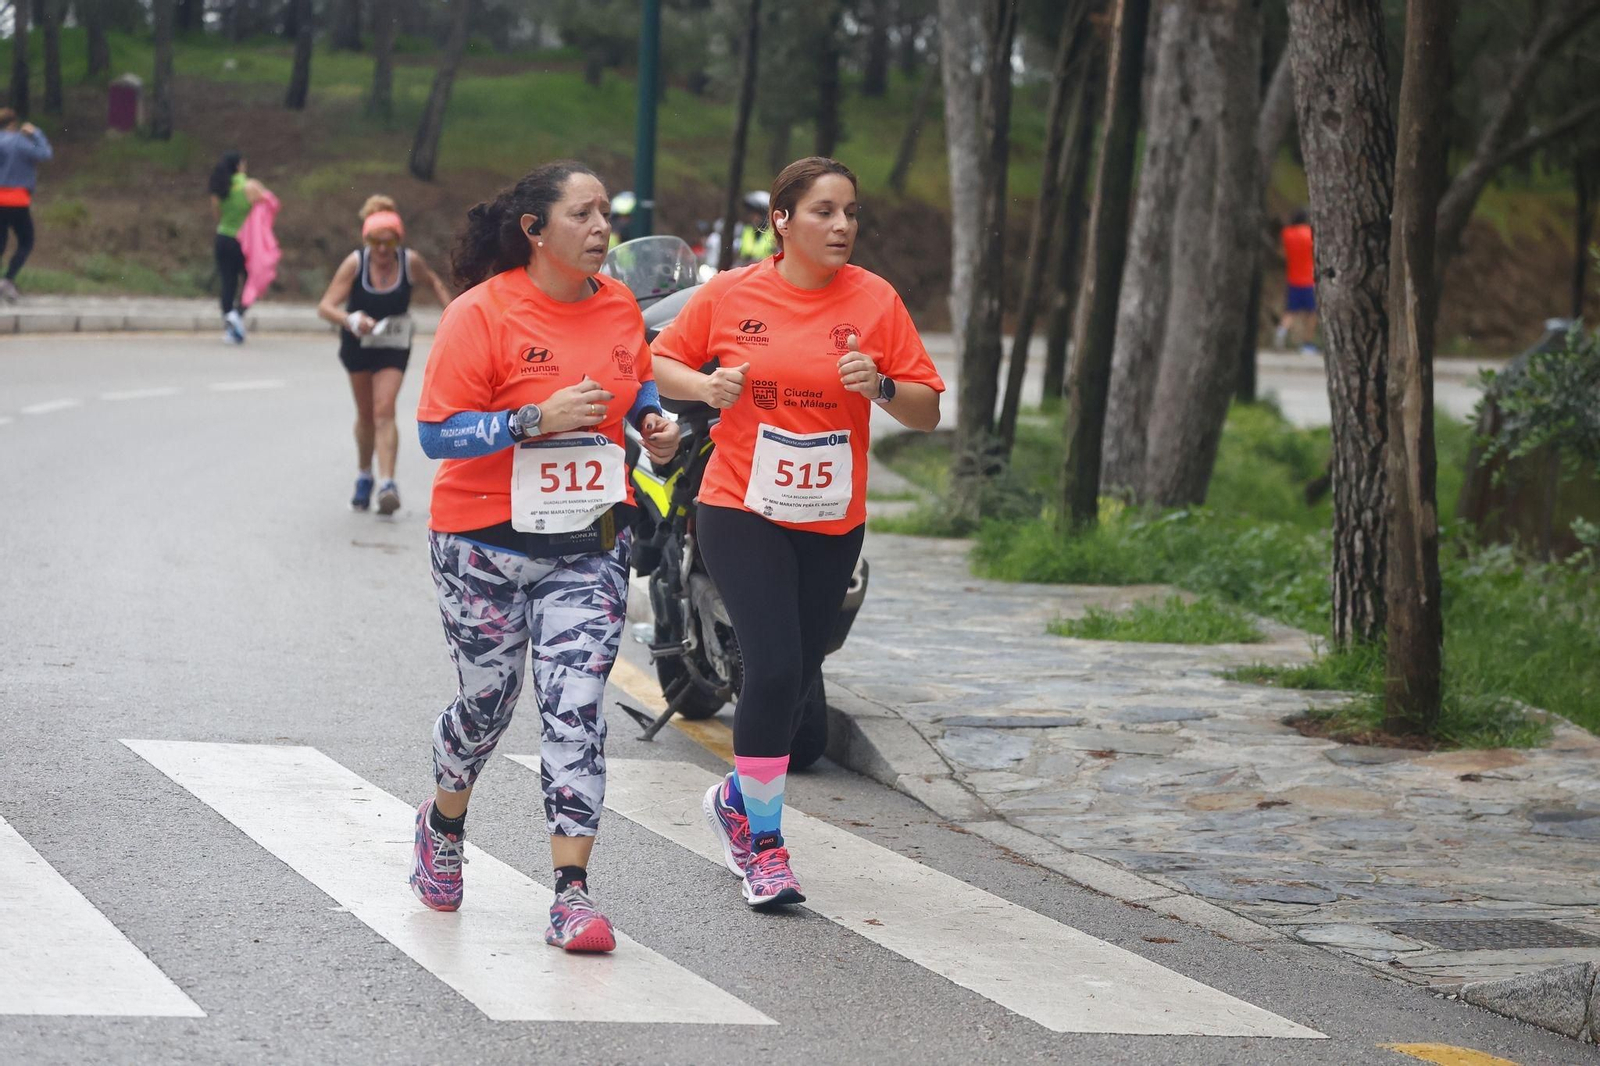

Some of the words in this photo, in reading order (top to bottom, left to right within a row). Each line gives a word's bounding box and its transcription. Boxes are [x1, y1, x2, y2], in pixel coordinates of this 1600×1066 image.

[736, 335, 769, 343] HYUNDAI
[520, 365, 559, 374] HYUNDAI
[784, 388, 823, 398] Ciudad
[784, 399, 797, 407] de
[800, 399, 837, 409] Málaga
[454, 439, 468, 447] CLUB
[540, 460, 604, 493] 512
[775, 459, 833, 489] 515
